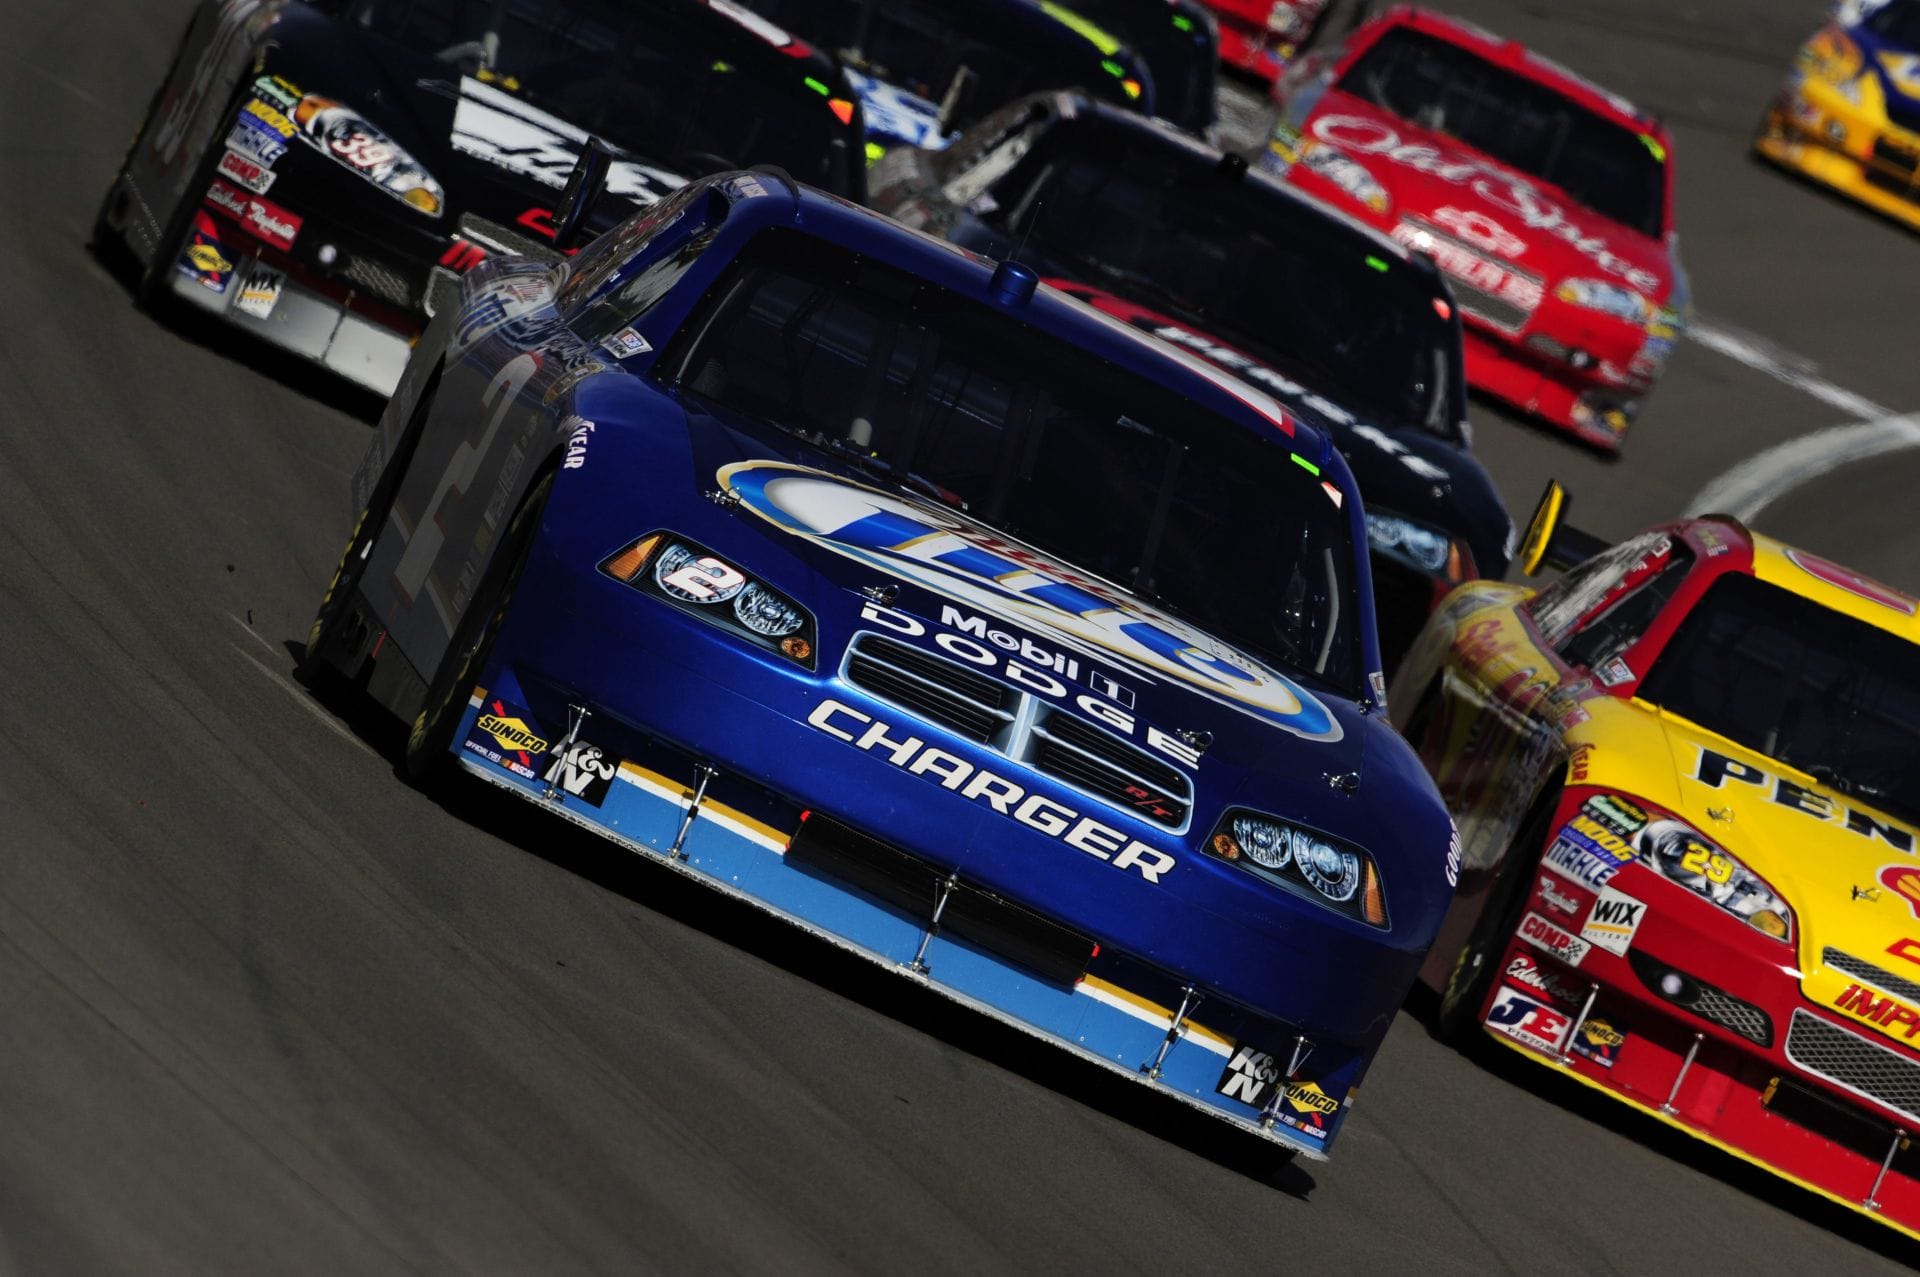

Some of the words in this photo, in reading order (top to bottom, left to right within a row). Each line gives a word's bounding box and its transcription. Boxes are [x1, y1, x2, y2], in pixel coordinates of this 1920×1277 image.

[331, 133, 395, 167] 39
[662, 557, 747, 598] 2
[941, 604, 1079, 680] Mobil
[860, 601, 1202, 771] DODGE
[480, 716, 546, 753] SUNOCO
[807, 699, 1177, 885] CHARGER
[1125, 785, 1176, 818] R/T
[1571, 815, 1640, 861] MOOG
[1546, 838, 1614, 888] MAHLE
[1680, 842, 1734, 885] 29
[1523, 917, 1571, 949] COMP
[1594, 899, 1640, 927] WIX
[1583, 930, 1630, 941] FILTERS
[1488, 997, 1569, 1044] JE
[1281, 1083, 1336, 1113] UNOCO
